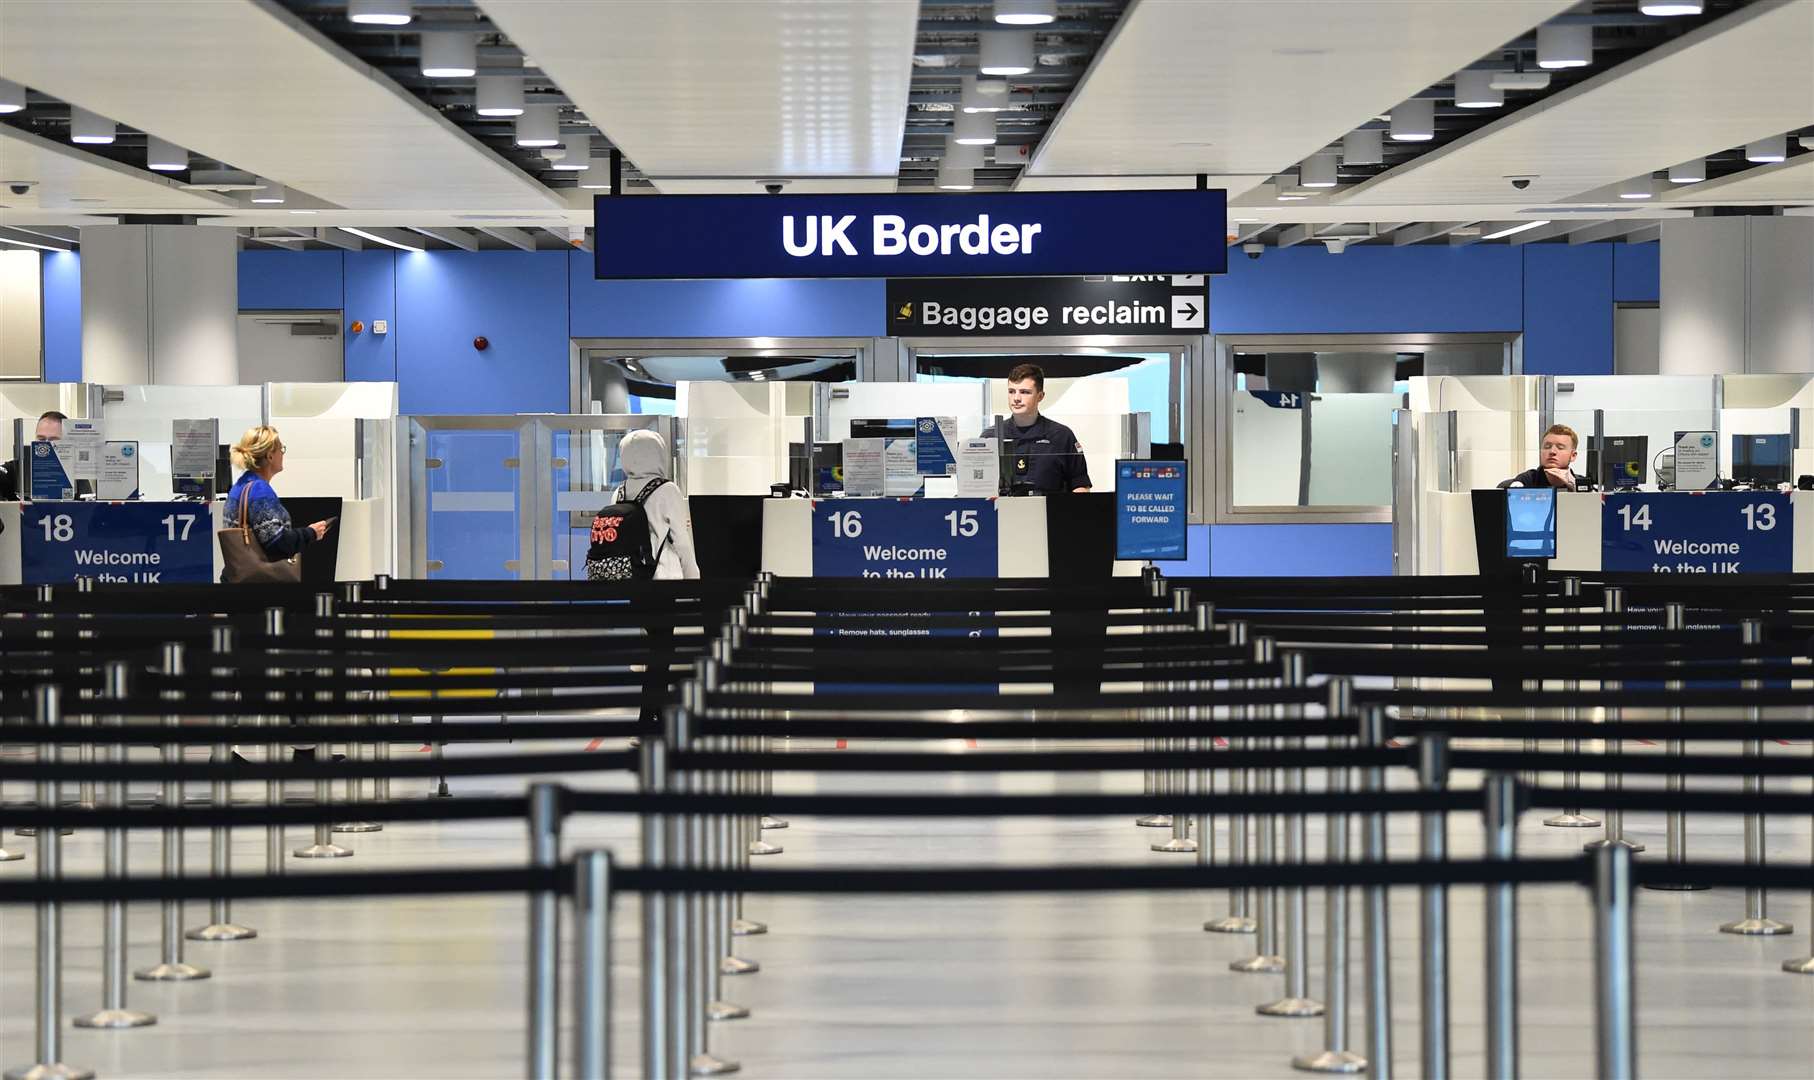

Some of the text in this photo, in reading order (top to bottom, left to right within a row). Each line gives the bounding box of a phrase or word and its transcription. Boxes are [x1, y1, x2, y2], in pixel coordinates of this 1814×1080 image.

[783, 215, 1042, 257] UK Border
[922, 300, 1165, 330] Baggage reclaim
[1127, 493, 1173, 501] PLEASE WAIT
[38, 514, 74, 542] 18
[161, 514, 196, 541] 17
[828, 510, 863, 538] 16
[944, 510, 979, 537] 15
[1131, 516, 1169, 524] FORWARD
[1617, 503, 1653, 531] 14
[1740, 503, 1776, 531] 13
[74, 550, 160, 564] Welcome
[863, 546, 947, 561] Welcome
[1654, 539, 1740, 554] Welcome
[889, 629, 930, 637] sunglasses
